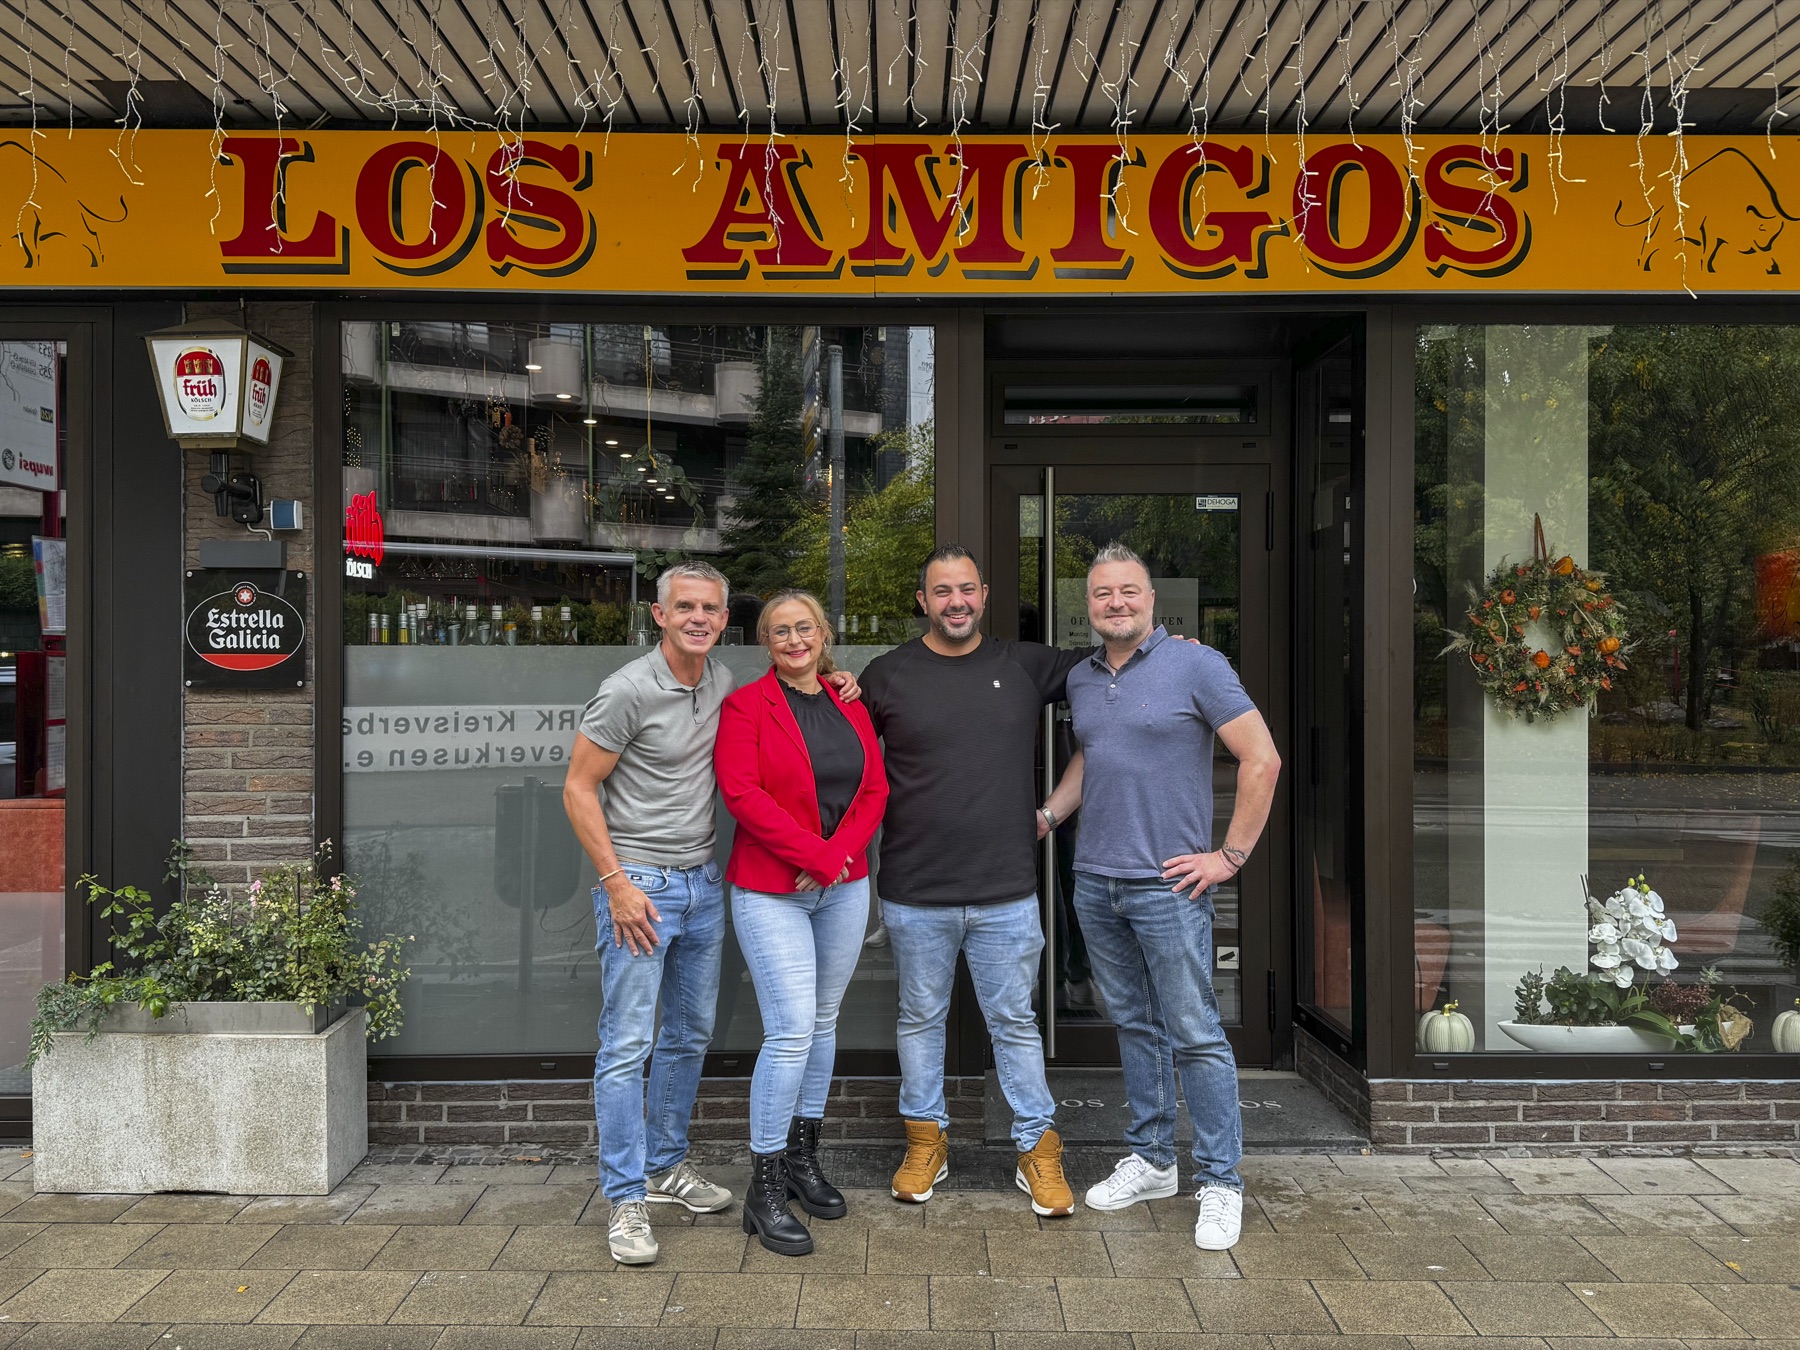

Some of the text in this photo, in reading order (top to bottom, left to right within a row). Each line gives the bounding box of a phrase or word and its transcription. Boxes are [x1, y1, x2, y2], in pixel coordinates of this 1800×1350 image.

[219, 137, 1532, 280] LOS AMIGOS
[183, 377, 218, 399] früh
[252, 382, 266, 407] früh
[206, 607, 285, 629] Estrella
[208, 628, 281, 650] Galicia
[1054, 1098, 1106, 1109] OS
